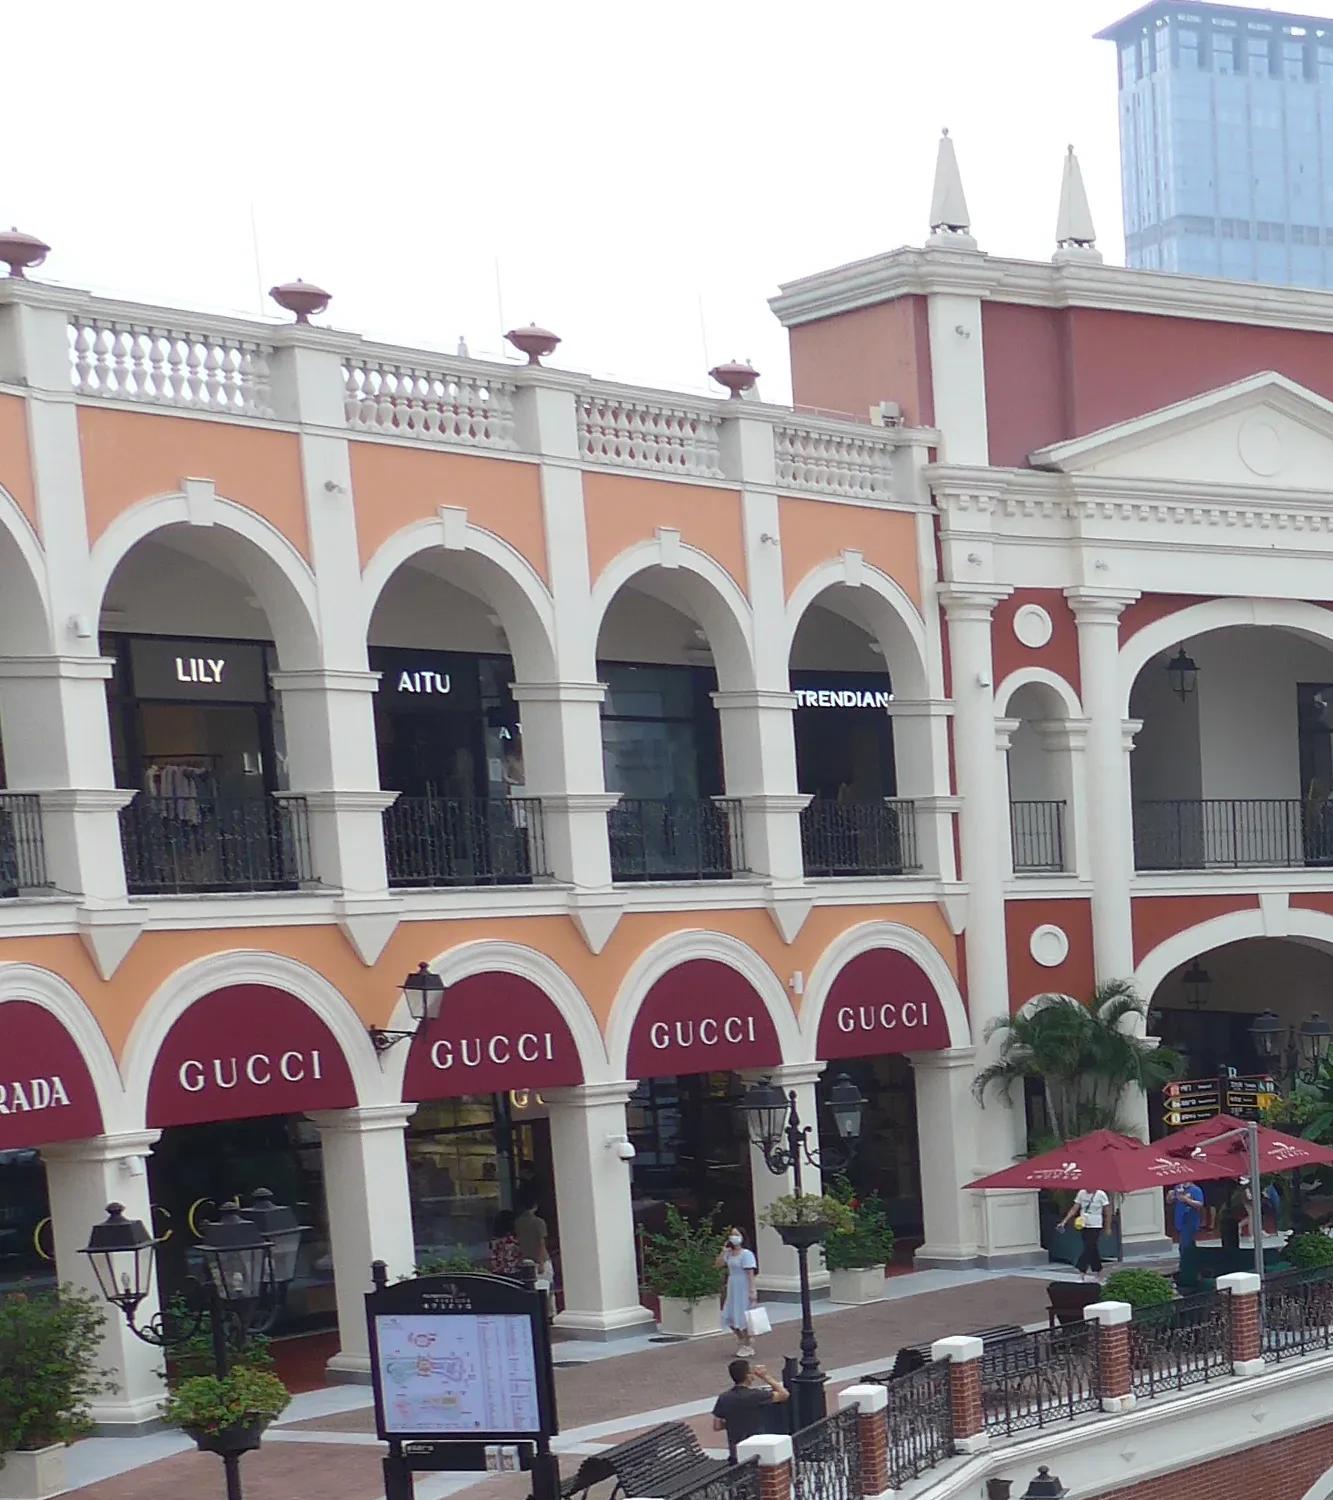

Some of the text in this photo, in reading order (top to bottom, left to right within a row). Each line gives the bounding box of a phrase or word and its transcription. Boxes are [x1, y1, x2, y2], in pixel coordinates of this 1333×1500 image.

[175, 657, 225, 683] LILY
[398, 671, 451, 694] AITU
[650, 1016, 757, 1049] GUCCI
[838, 1002, 929, 1033] GUCCI
[431, 1033, 554, 1070] GUCCI
[179, 1050, 322, 1092] GUCCI
